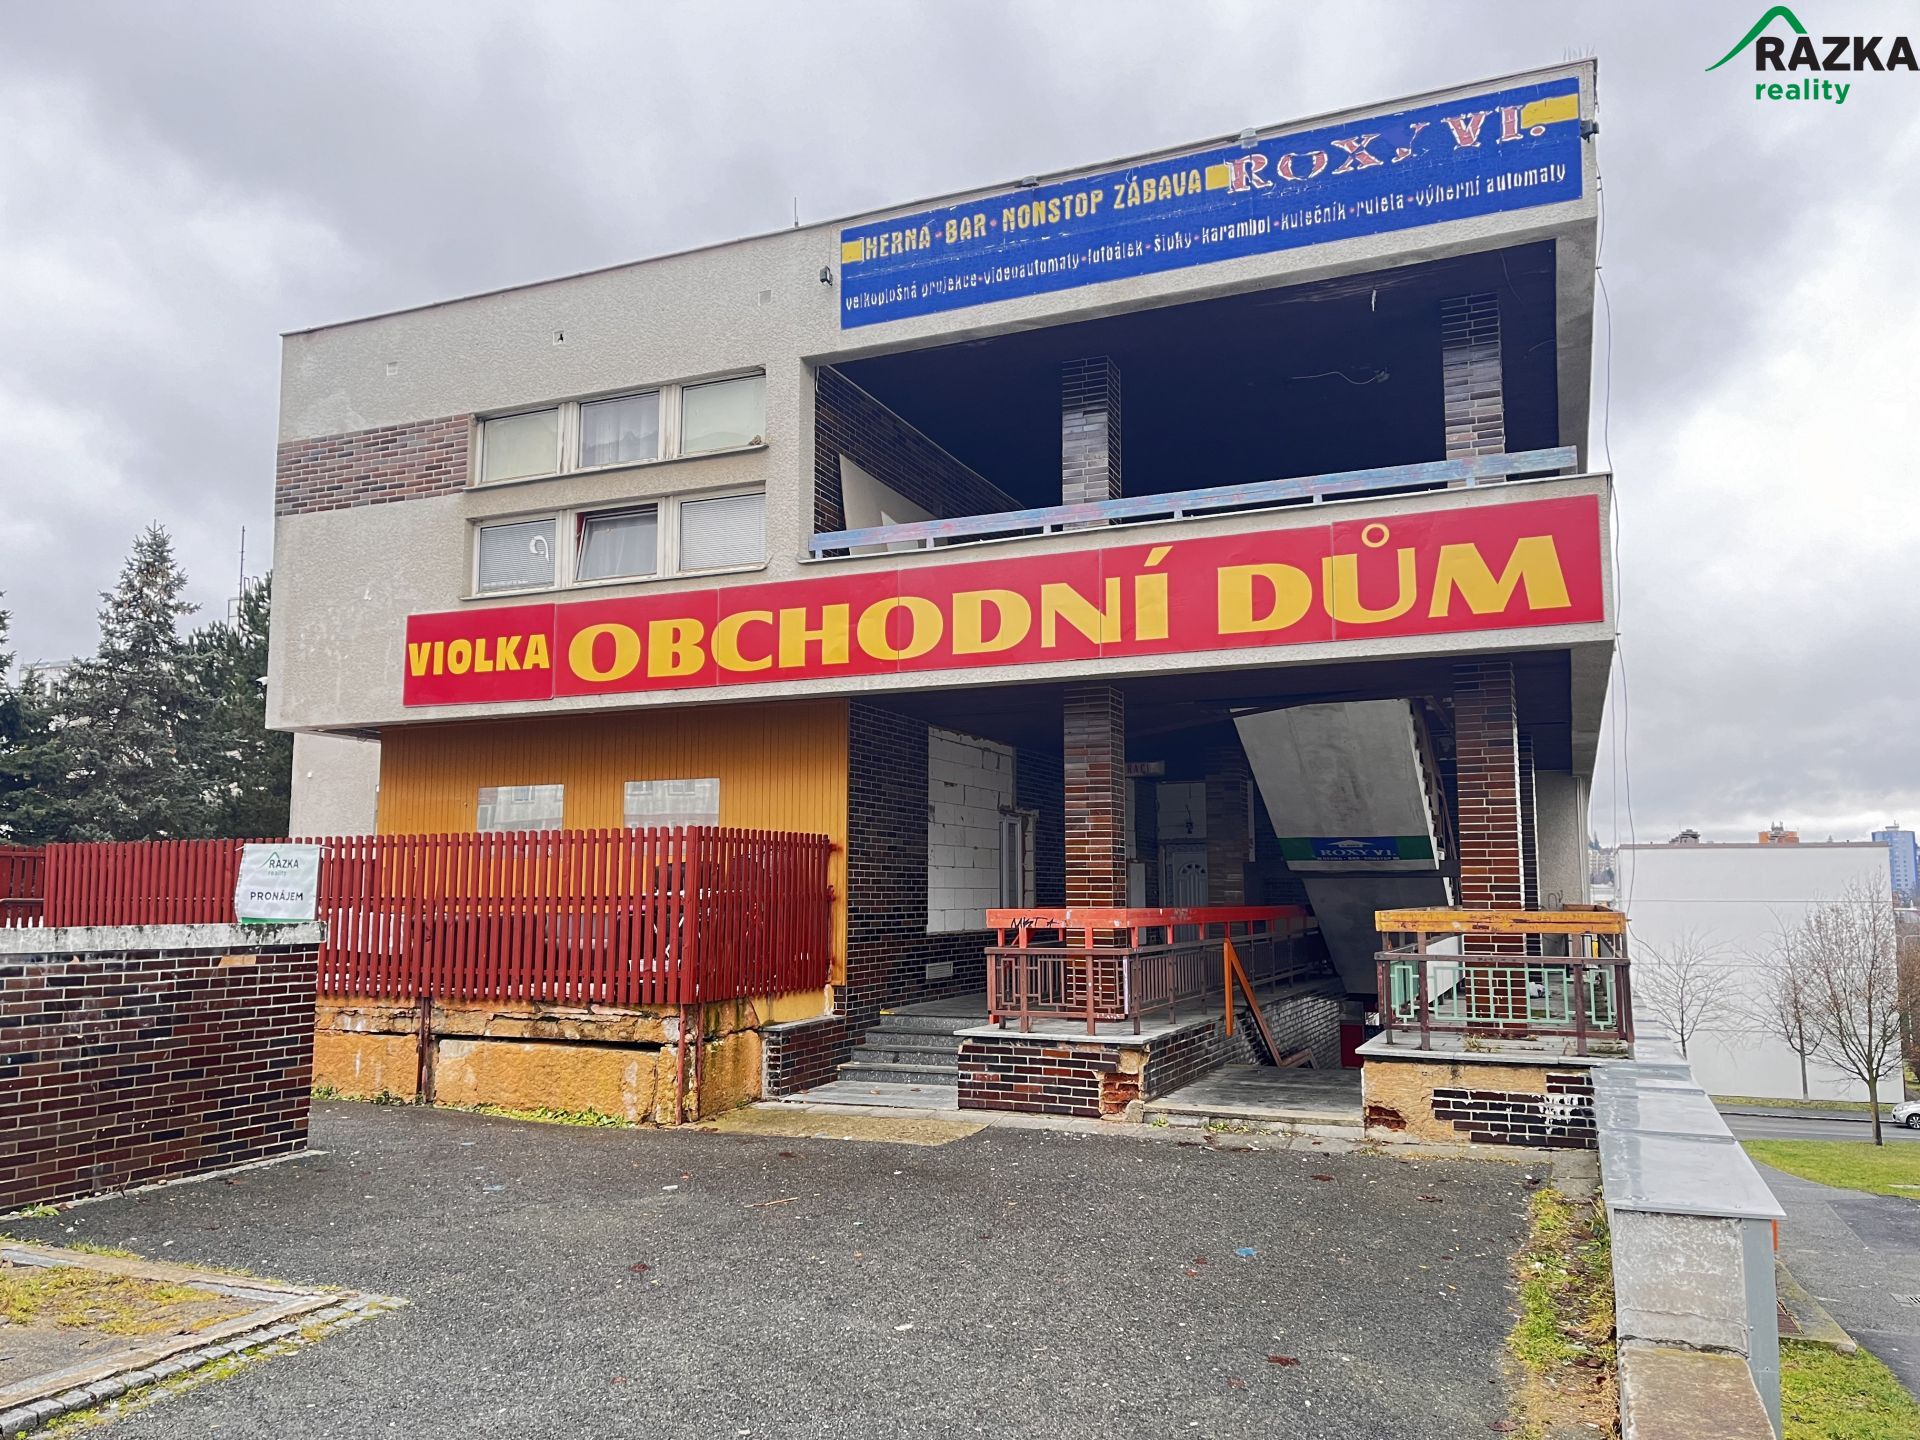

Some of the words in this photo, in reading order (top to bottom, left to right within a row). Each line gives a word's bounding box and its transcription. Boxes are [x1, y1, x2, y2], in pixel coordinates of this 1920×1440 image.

[1440, 104, 1546, 150] VI.
[863, 226, 931, 260] HERNA
[945, 213, 987, 244] BAR
[1002, 190, 1104, 233] NONSTOP
[1113, 169, 1202, 210] ZÁBAVA
[407, 634, 550, 677] VIOLKA
[567, 545, 1173, 682] OBCHODNÍ
[1217, 522, 1572, 635] DŮM
[269, 859, 299, 869] RAZKA
[250, 890, 304, 901] PRONÁJEM
